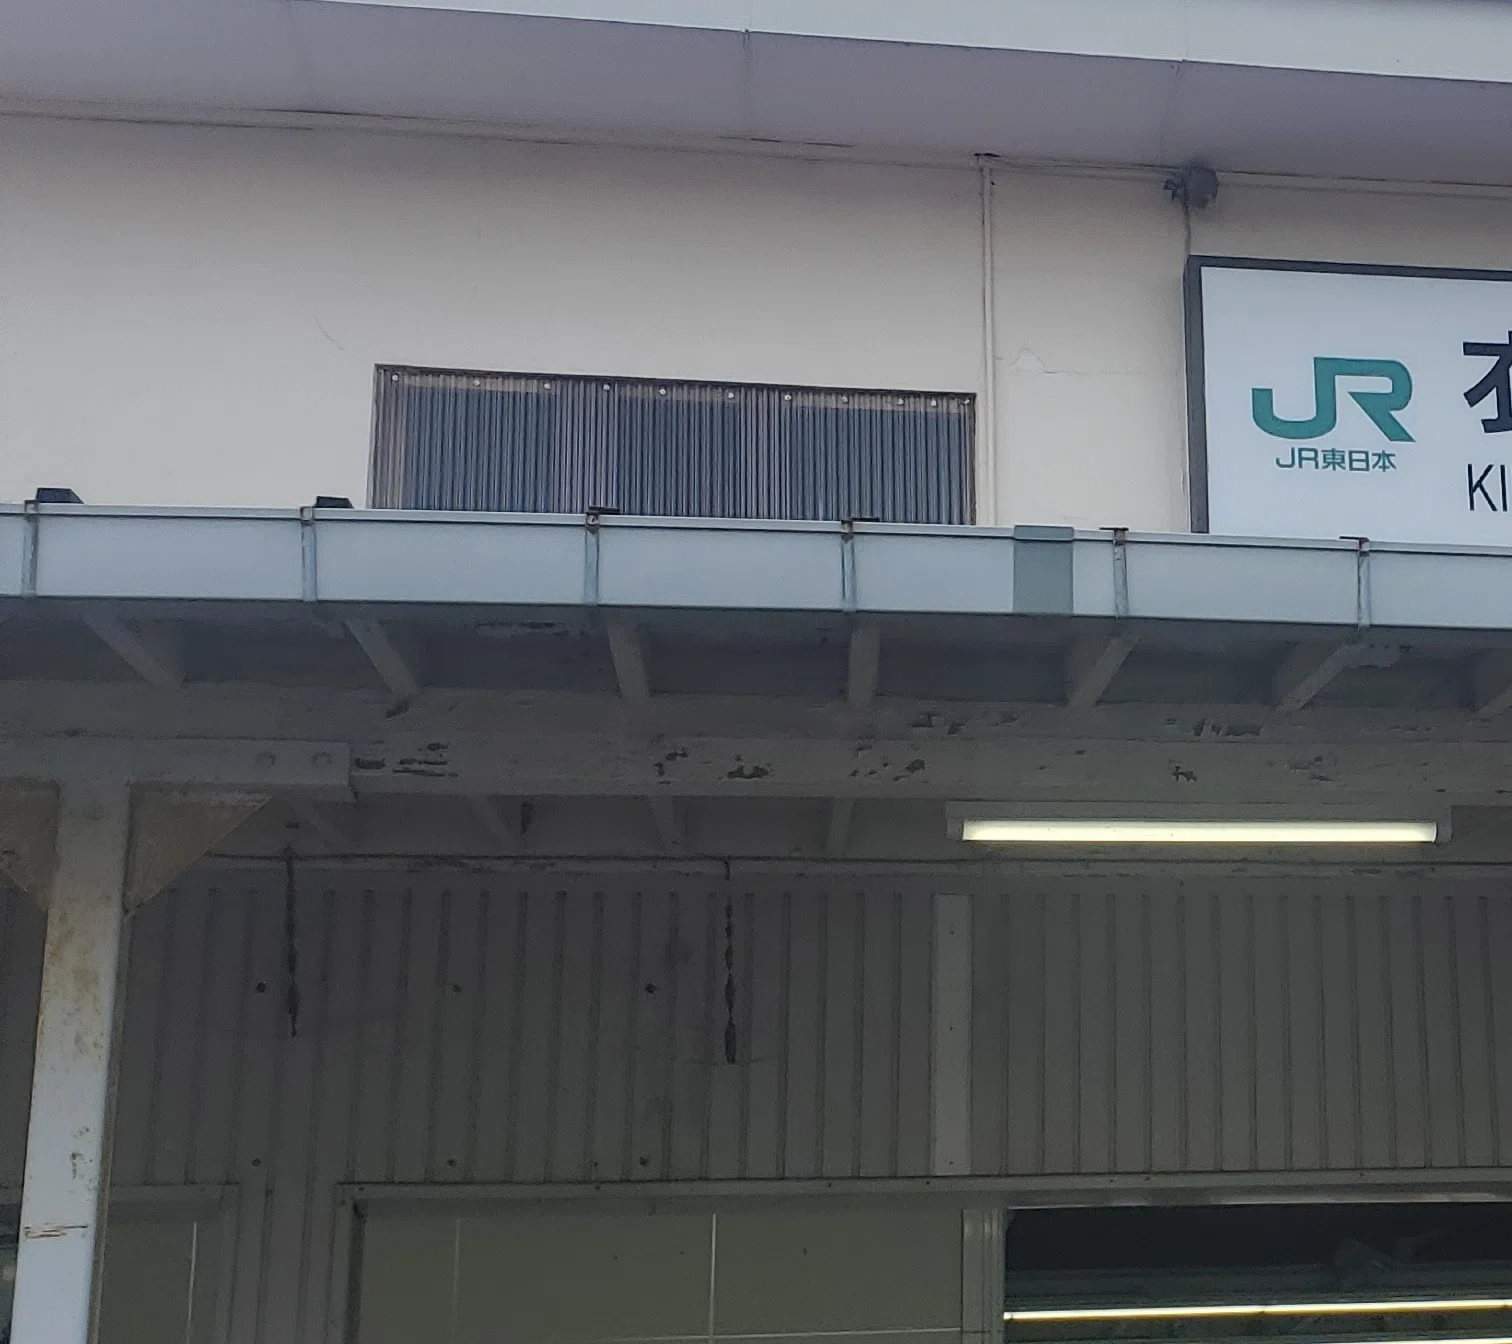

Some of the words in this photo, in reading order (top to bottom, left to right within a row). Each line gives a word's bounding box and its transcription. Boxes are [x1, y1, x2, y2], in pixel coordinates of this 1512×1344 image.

[1251, 357, 1416, 443] JR
[1275, 447, 1397, 473] JR東日本
